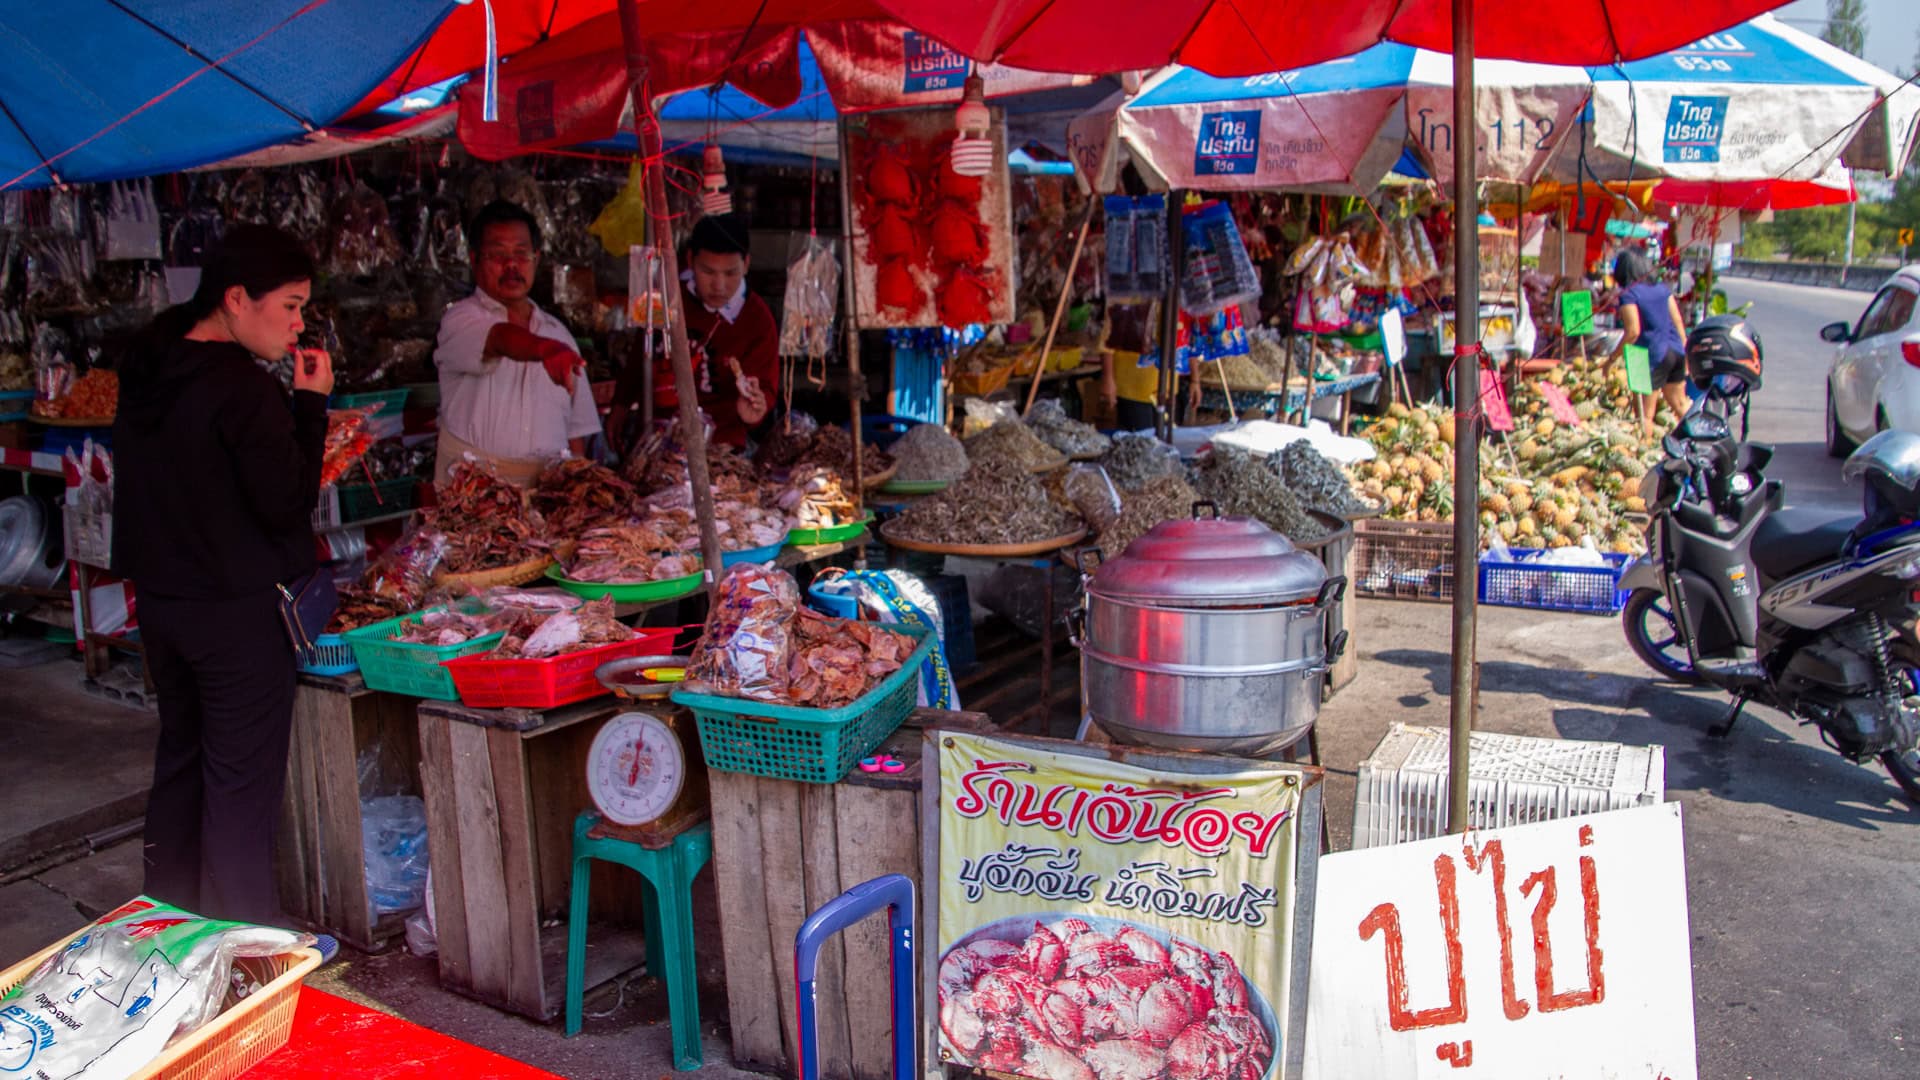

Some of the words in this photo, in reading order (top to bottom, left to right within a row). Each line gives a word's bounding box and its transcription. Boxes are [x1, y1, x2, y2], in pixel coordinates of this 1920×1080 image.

[1679, 100, 1712, 121] ไทย
[1211, 117, 1246, 136] ไทย
[1668, 120, 1719, 140] ประกัน
[1200, 135, 1254, 154] ประกัน
[955, 759, 1289, 856] ร้านเจ๊น้อย
[1105, 862, 1278, 924] น้ำจิ้มฟรี
[1358, 825, 1605, 1068] ปูไข่
